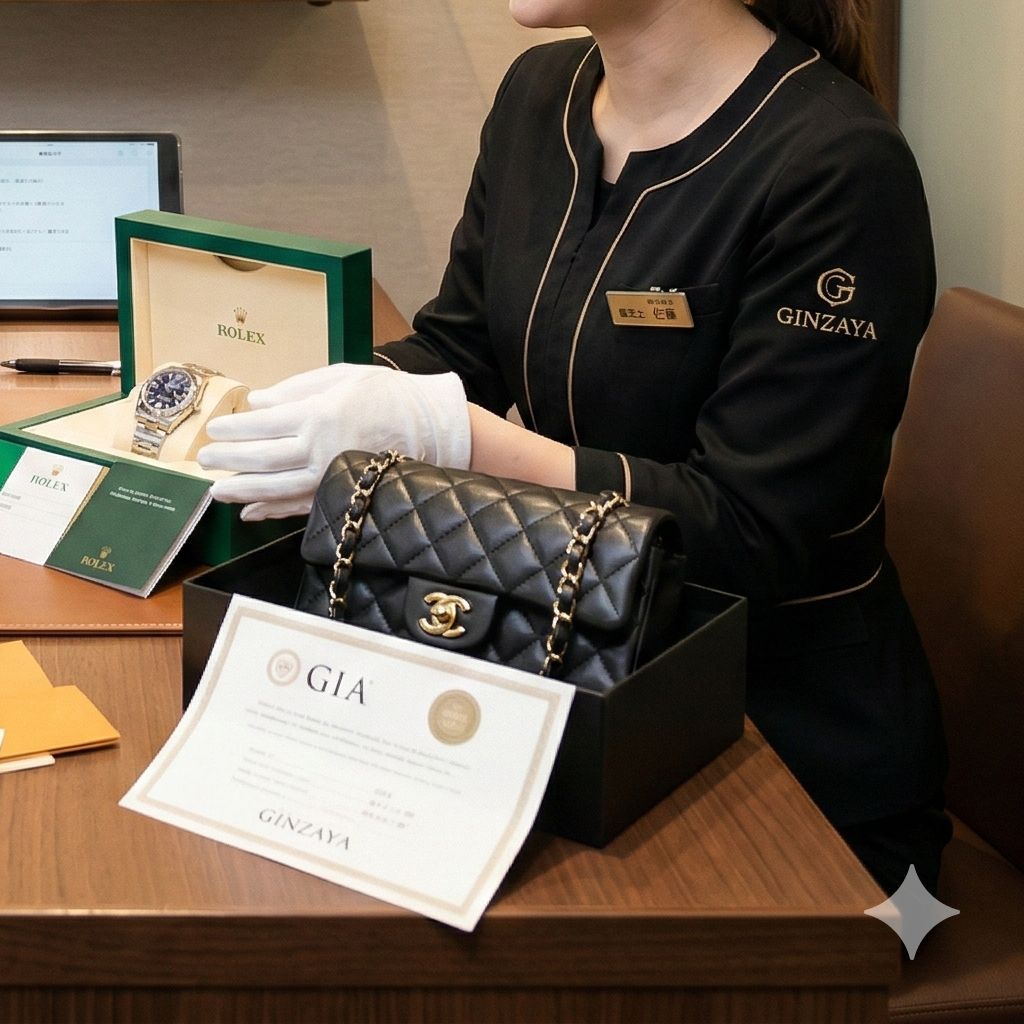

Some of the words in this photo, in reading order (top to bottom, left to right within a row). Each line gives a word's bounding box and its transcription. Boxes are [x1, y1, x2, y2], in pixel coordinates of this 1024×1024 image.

[216, 323, 266, 346] ROLEX
[776, 307, 878, 340] GINZAYA
[80, 555, 116, 573] ROLEX
[306, 663, 366, 706] GIA
[258, 807, 351, 851] GINZAYA
